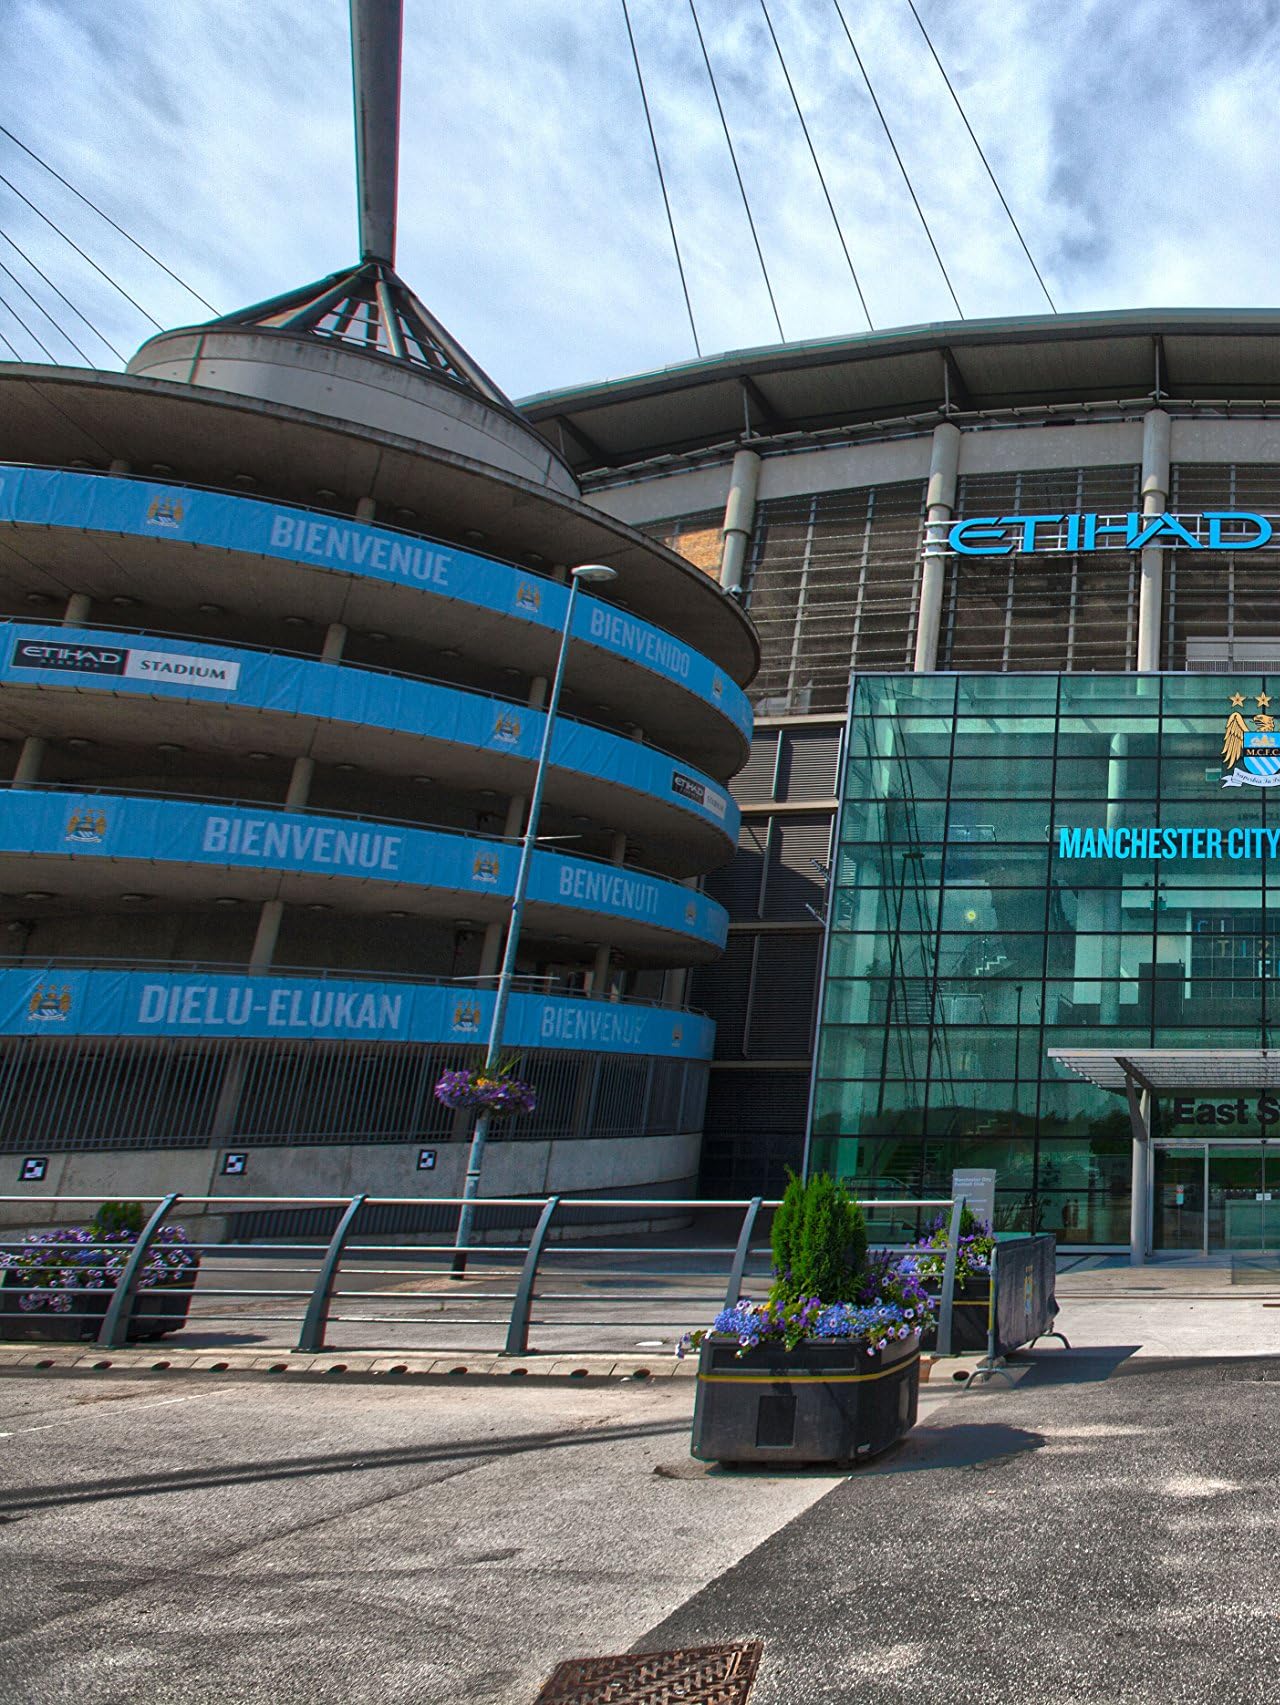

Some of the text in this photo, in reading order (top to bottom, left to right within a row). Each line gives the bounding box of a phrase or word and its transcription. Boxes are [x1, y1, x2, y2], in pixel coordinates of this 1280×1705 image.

[270, 514, 451, 586] BIENVENUE
[948, 511, 1273, 556] ETIHAD
[22, 646, 227, 680] ETIHAD STADIUM
[591, 607, 690, 678] BIENVENIDO
[203, 816, 402, 871] BIENVENUE
[1059, 827, 1222, 860] MANCHESTER
[560, 865, 659, 914] BENVENUTI
[138, 984, 402, 1030] DIELU-ELUKAN
[1173, 1097, 1249, 1125] East
